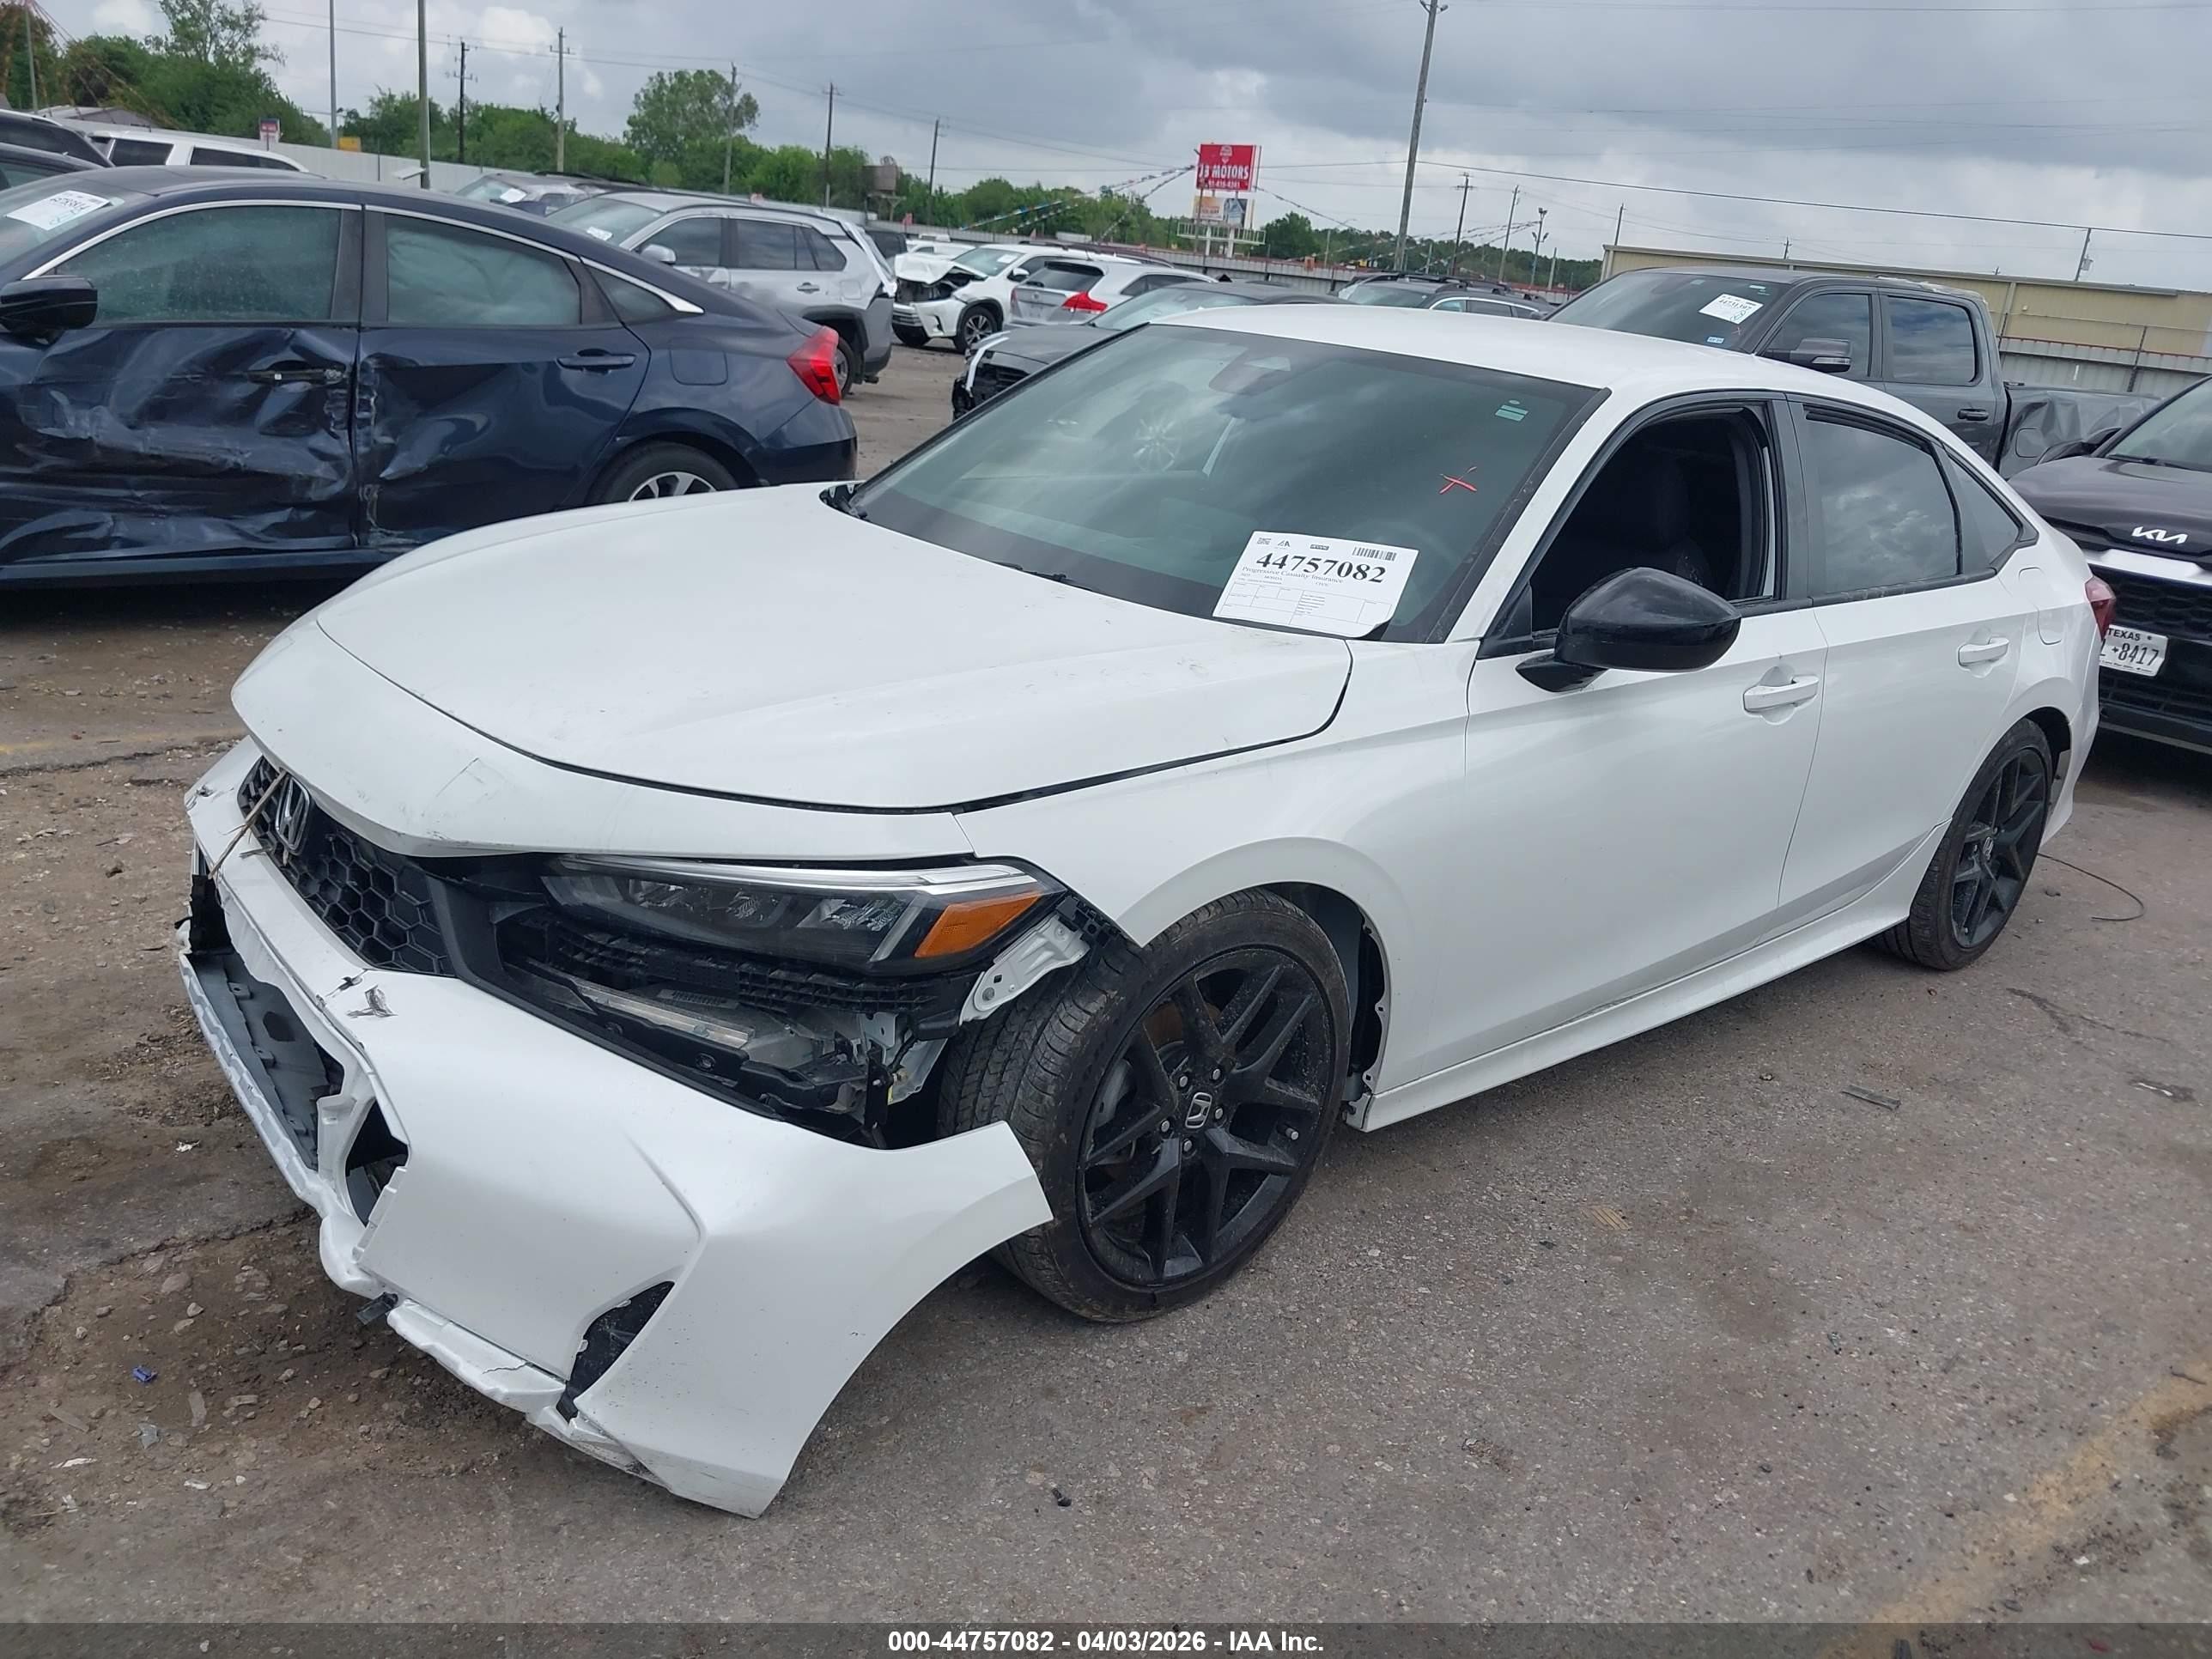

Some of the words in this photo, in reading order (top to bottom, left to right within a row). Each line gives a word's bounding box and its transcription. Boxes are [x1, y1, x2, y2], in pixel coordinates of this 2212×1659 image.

[1211, 165, 1249, 180] MOTORS
[1242, 566, 1280, 575] Progressive
[1281, 570, 1310, 580] Casualty
[1311, 574, 1344, 584] Insurance
[1255, 552, 1387, 583] 44757082
[2108, 628, 2142, 641] TEXAS
